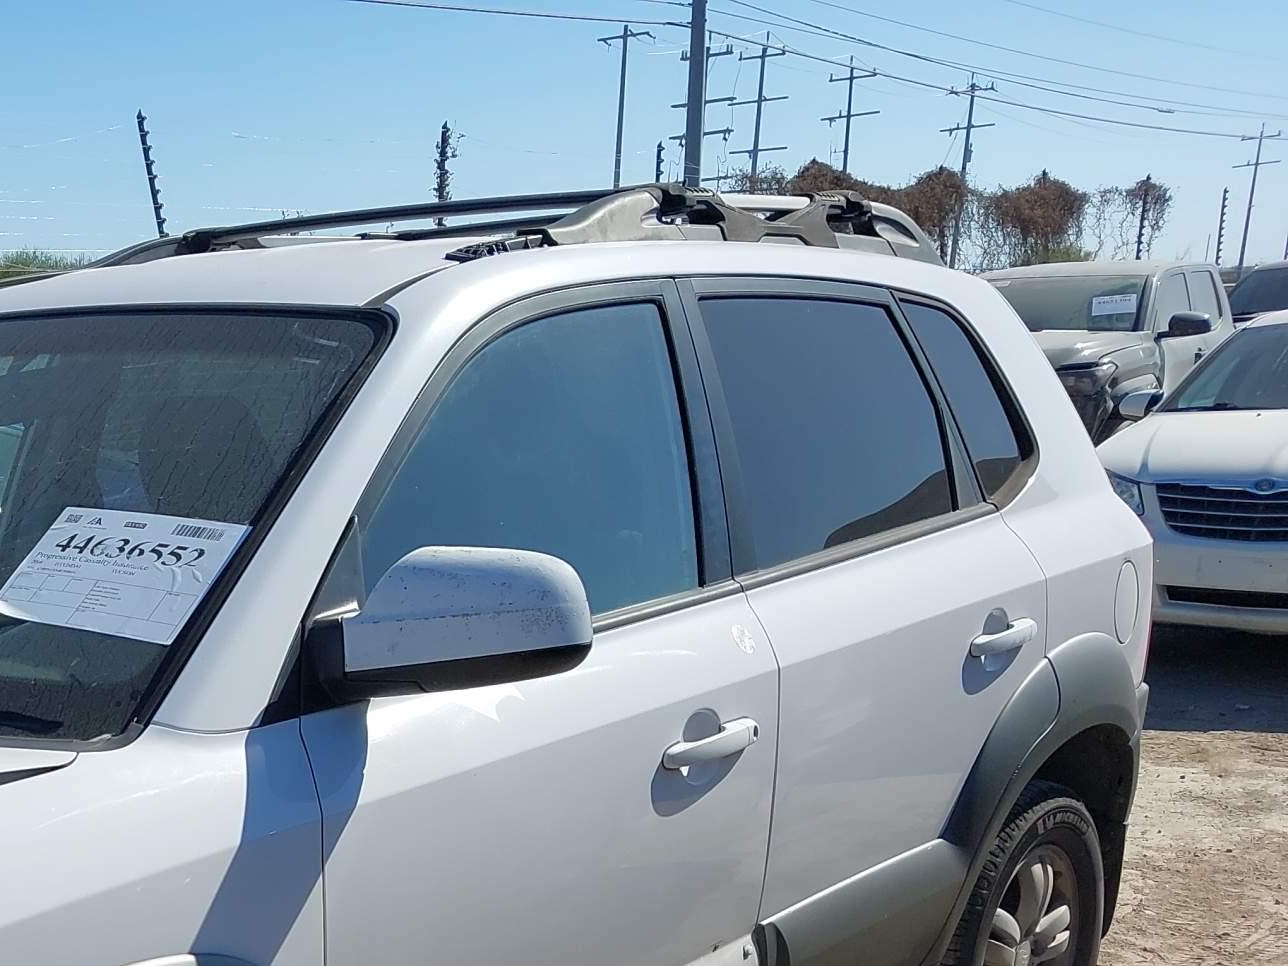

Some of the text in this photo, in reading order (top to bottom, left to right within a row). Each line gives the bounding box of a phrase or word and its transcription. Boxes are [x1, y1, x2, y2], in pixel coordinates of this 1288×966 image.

[35, 551, 78, 563] Progressive
[79, 556, 111, 567] Casualty
[55, 533, 205, 568] 44636552
